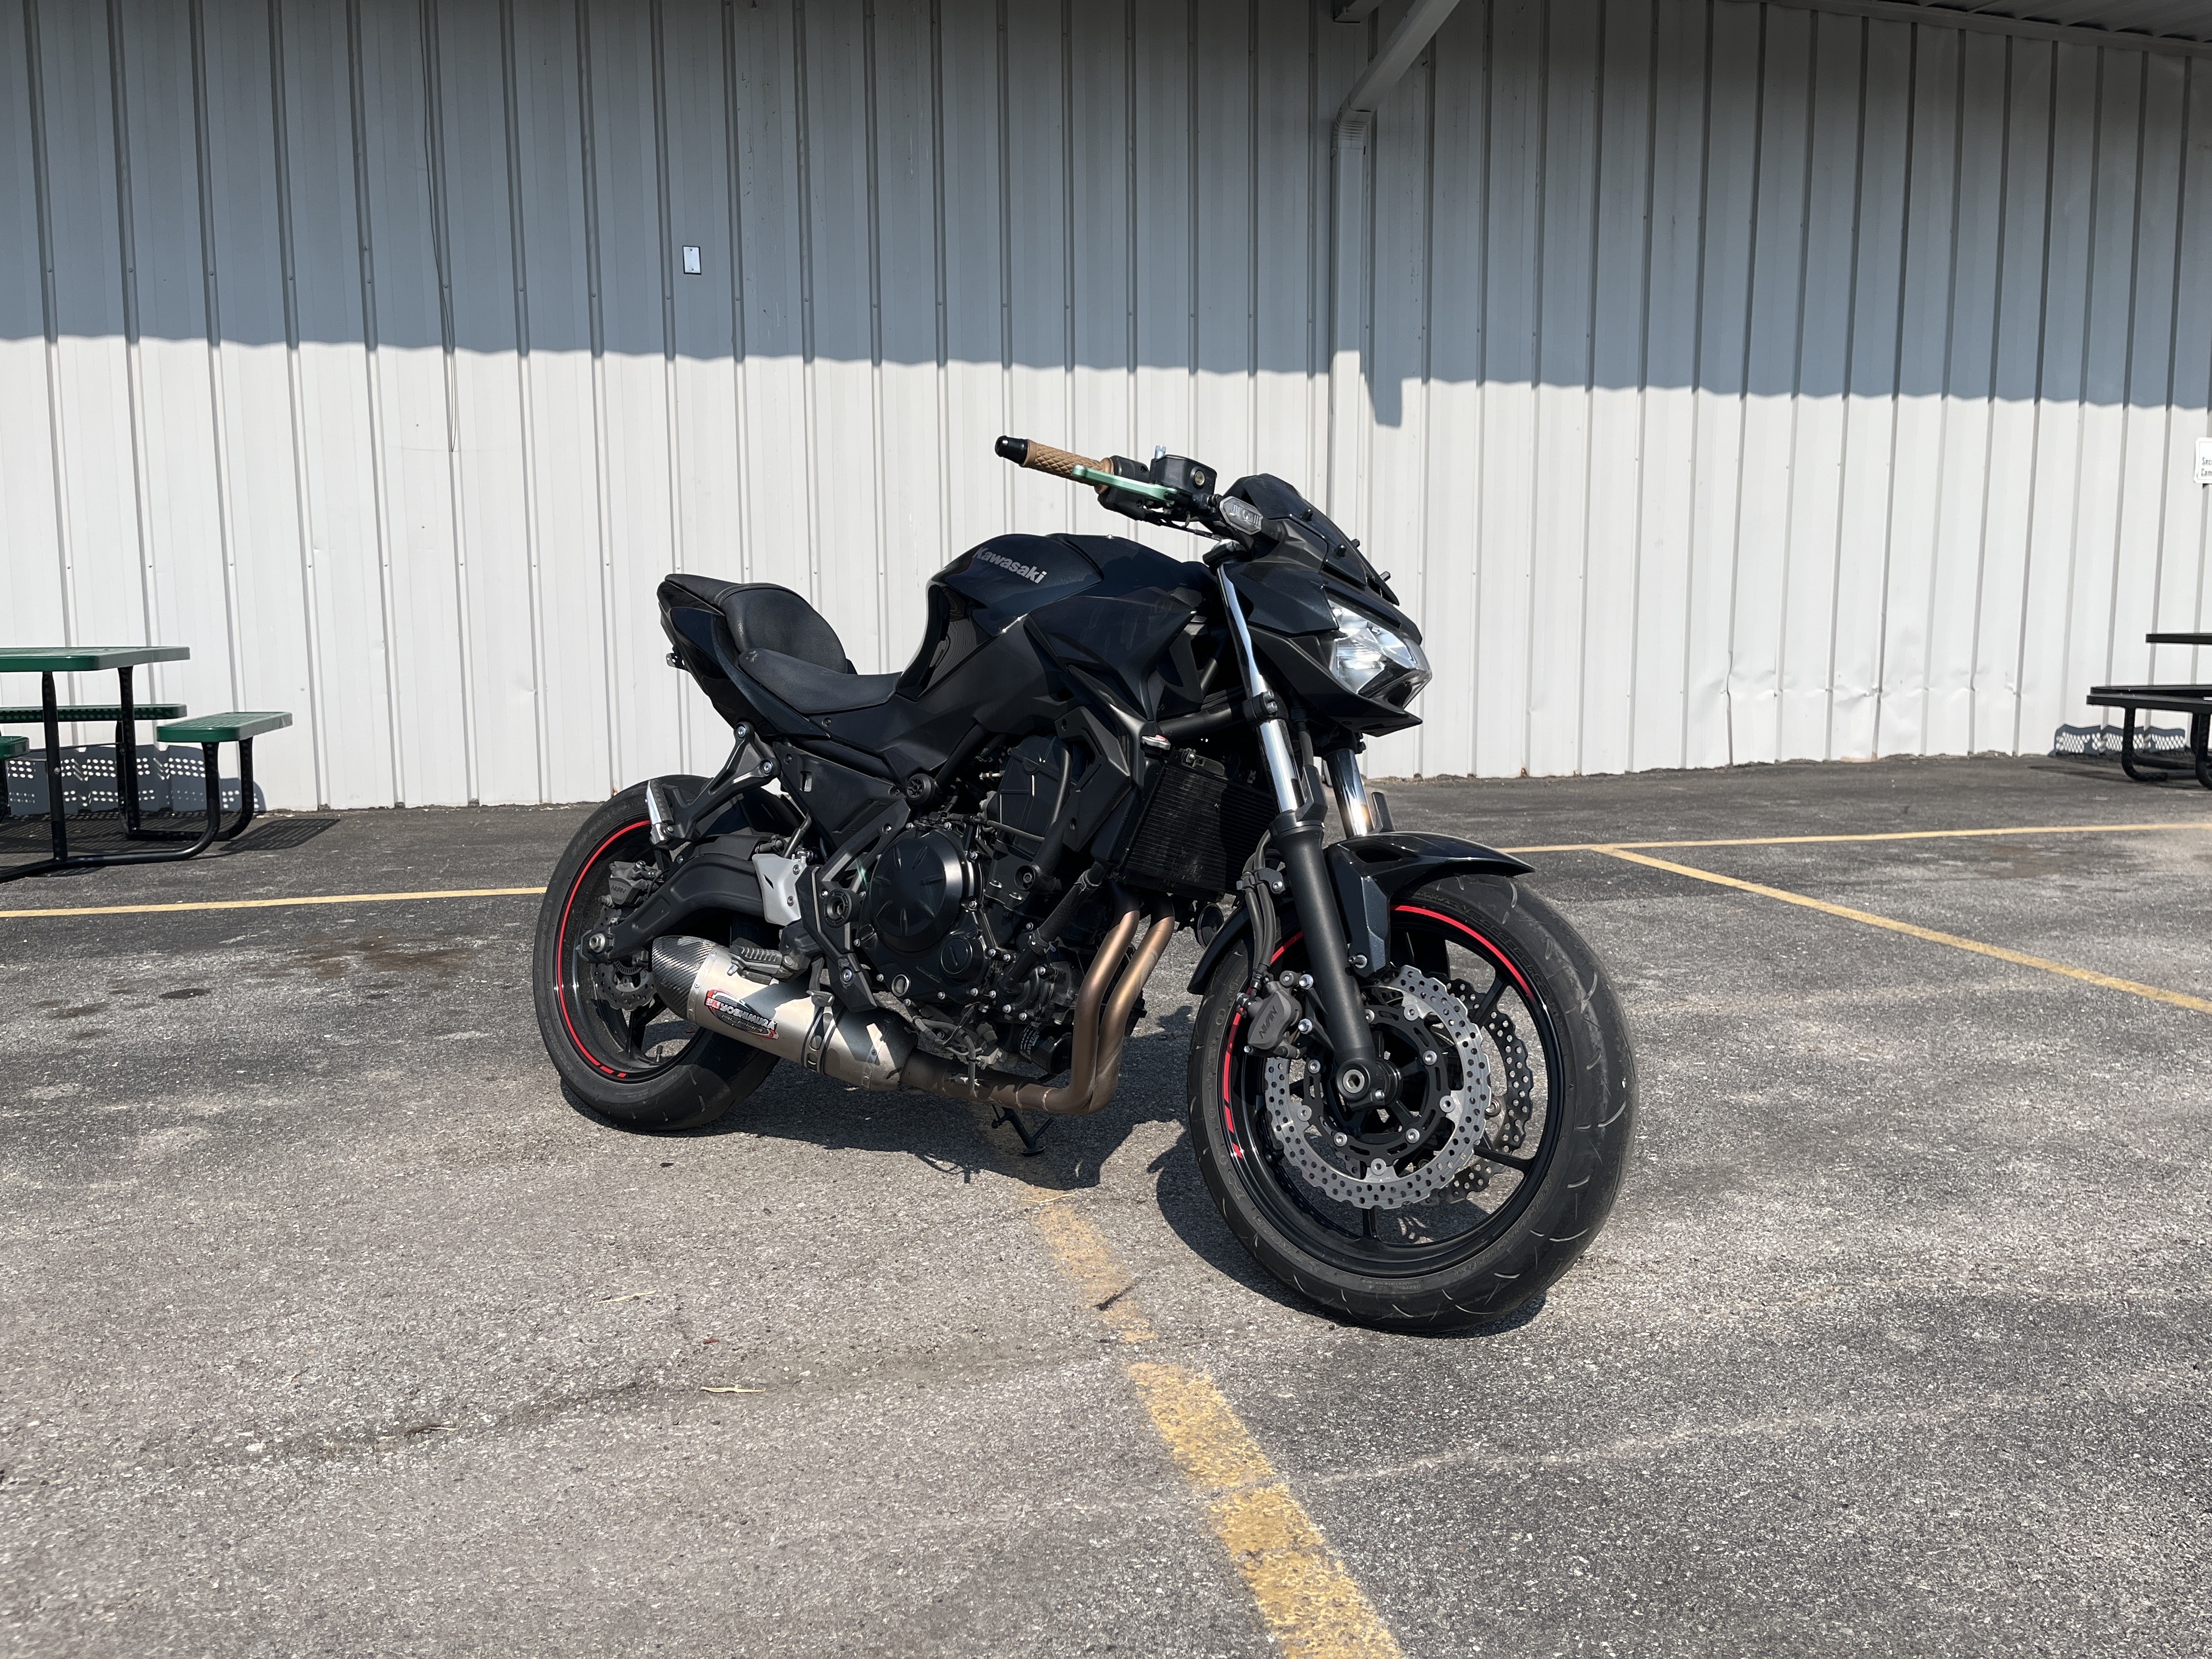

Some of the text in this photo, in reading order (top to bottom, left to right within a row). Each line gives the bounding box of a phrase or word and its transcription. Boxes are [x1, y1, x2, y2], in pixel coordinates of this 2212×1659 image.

[972, 547, 1047, 584] Kawasaki
[720, 1002, 777, 1031] YOSHIMURA
[721, 1014, 764, 1032] ALPHA
